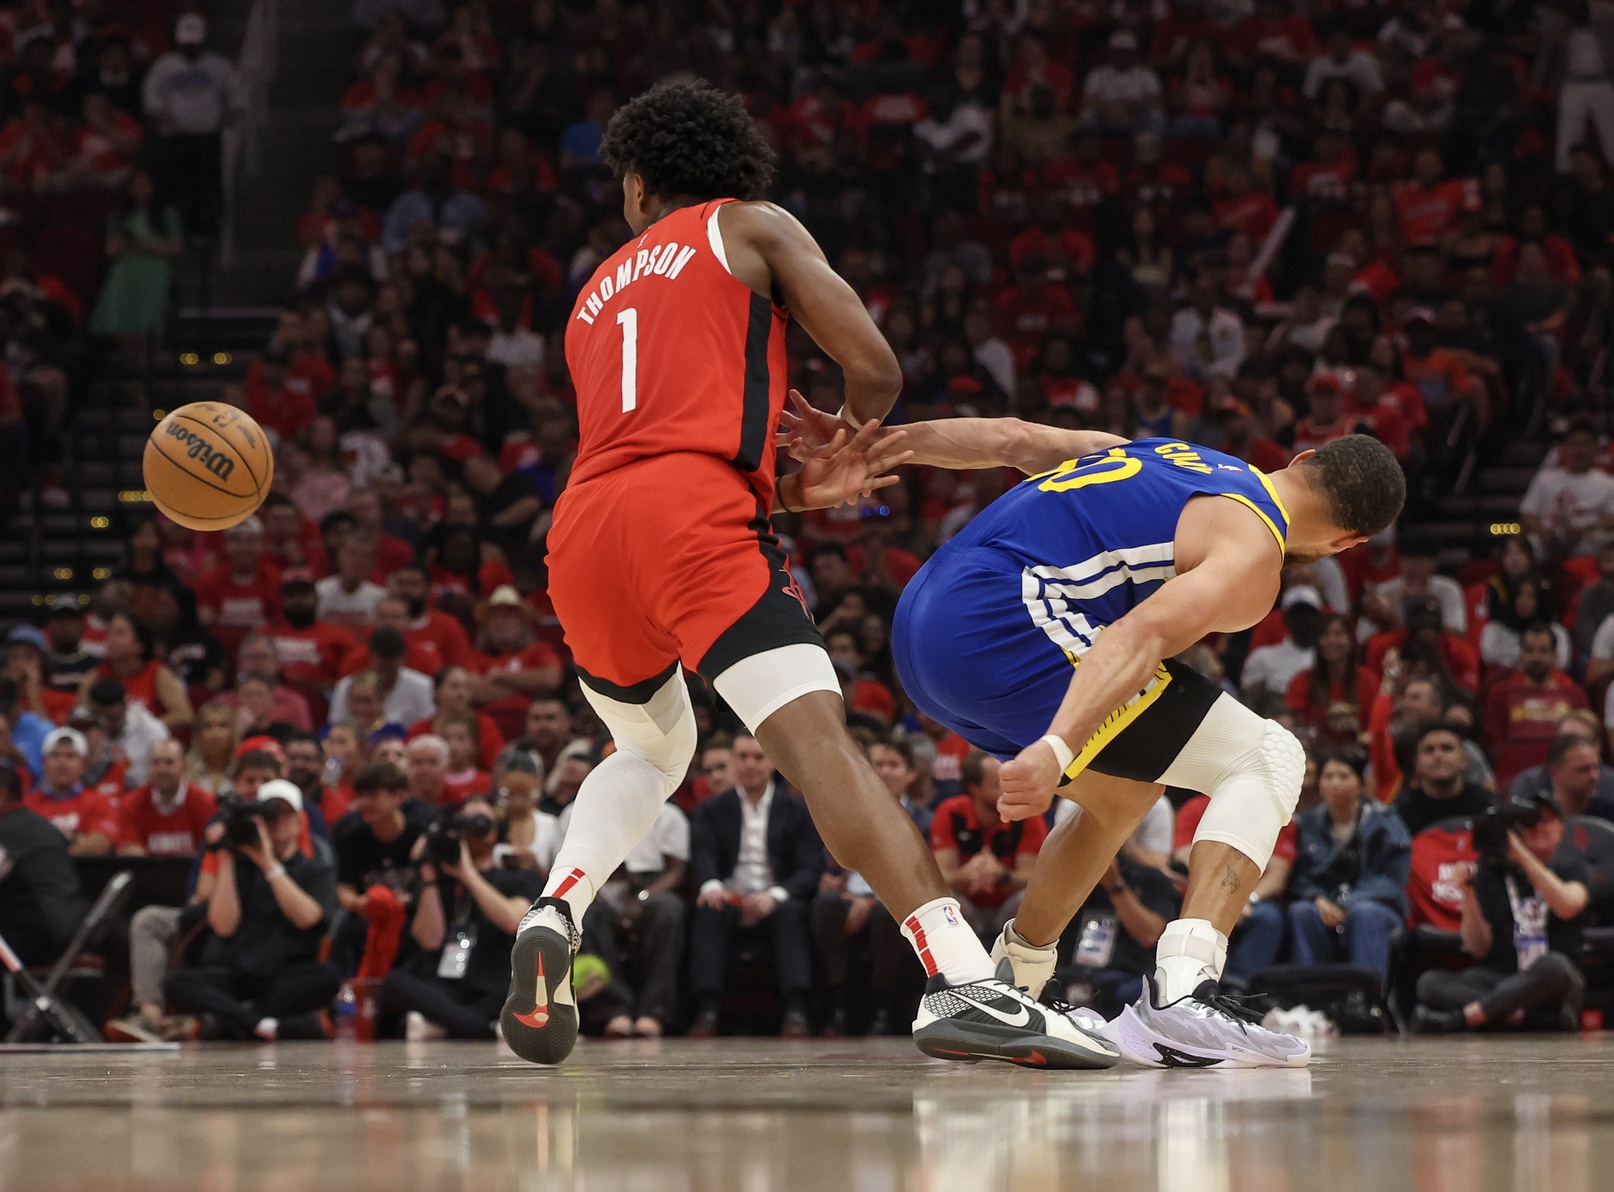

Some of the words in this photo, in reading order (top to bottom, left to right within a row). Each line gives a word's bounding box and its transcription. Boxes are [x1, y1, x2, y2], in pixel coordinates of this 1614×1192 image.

[576, 242, 697, 325] THOMPSON
[616, 307, 638, 414] 1
[165, 422, 235, 482] Wilson
